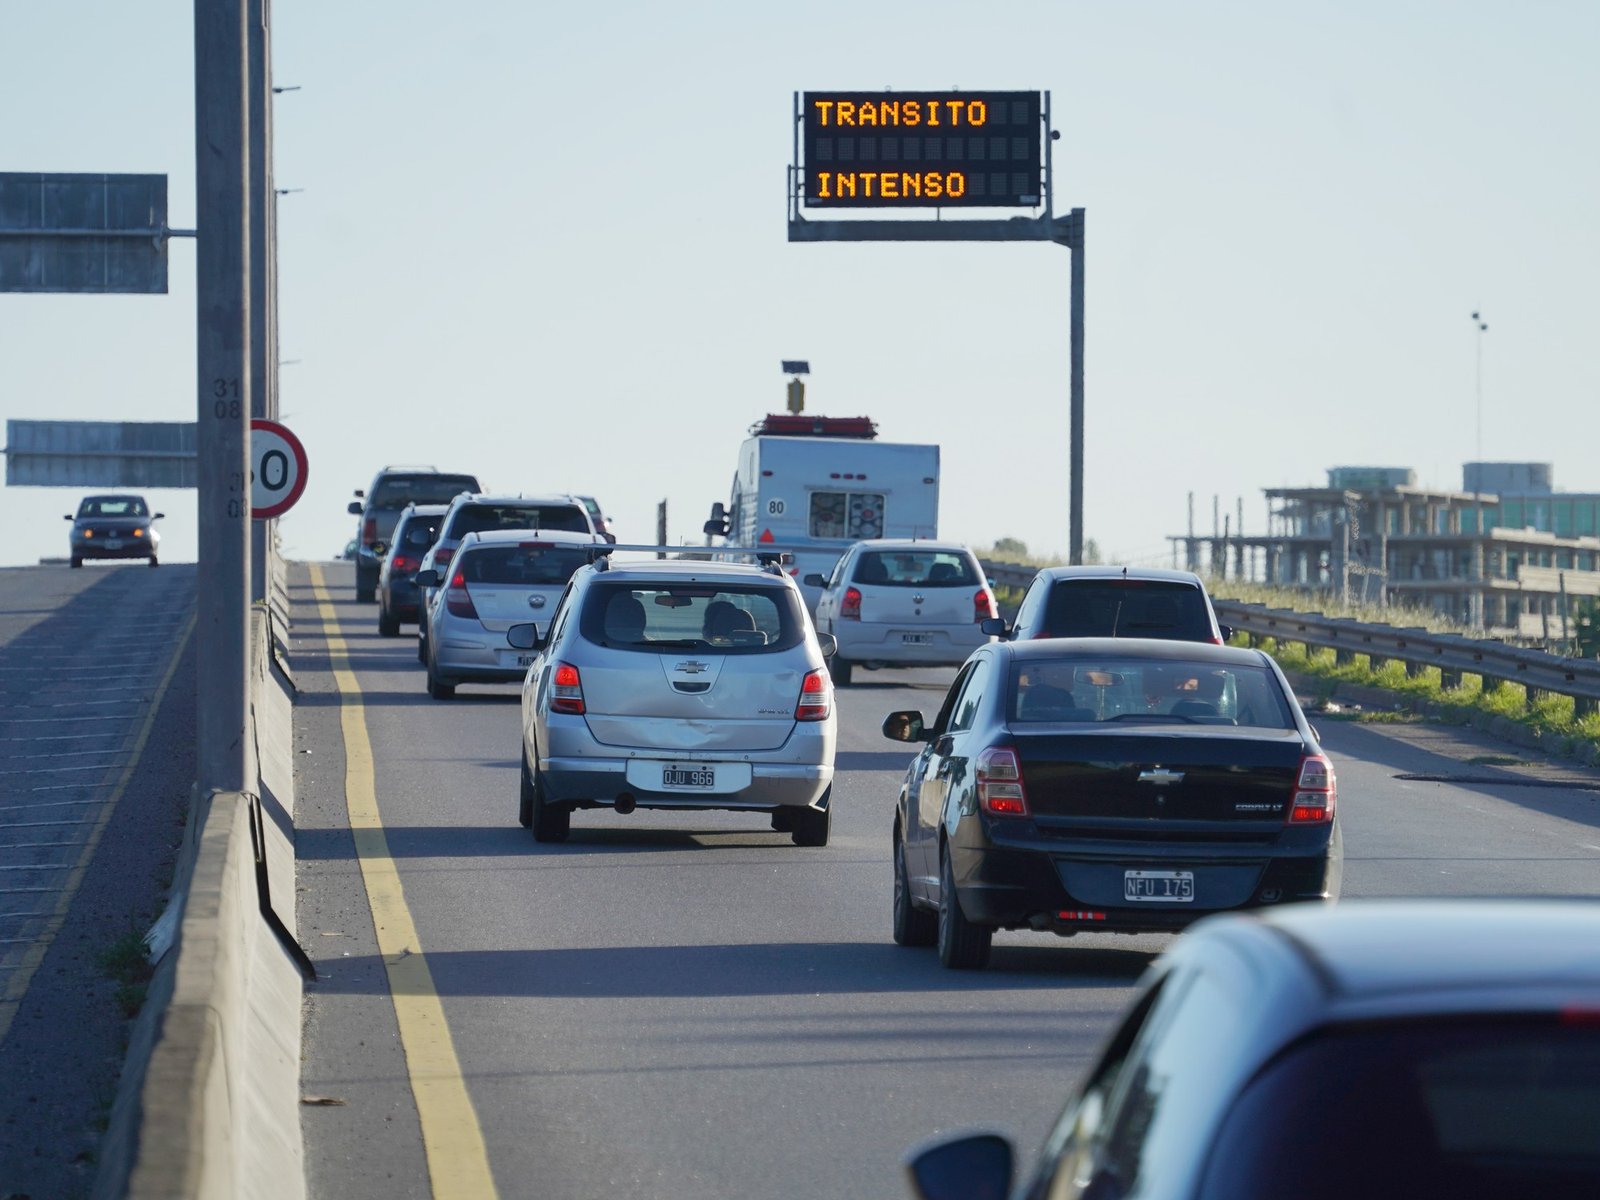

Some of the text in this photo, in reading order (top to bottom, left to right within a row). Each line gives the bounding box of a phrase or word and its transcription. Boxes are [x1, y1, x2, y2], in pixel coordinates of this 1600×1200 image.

[815, 101, 987, 126] TRANSITO
[818, 172, 965, 197] INTENSO
[250, 449, 289, 491] 0
[769, 500, 784, 514] 80
[691, 771, 713, 786] 966
[1127, 879, 1191, 896] NFU 175
